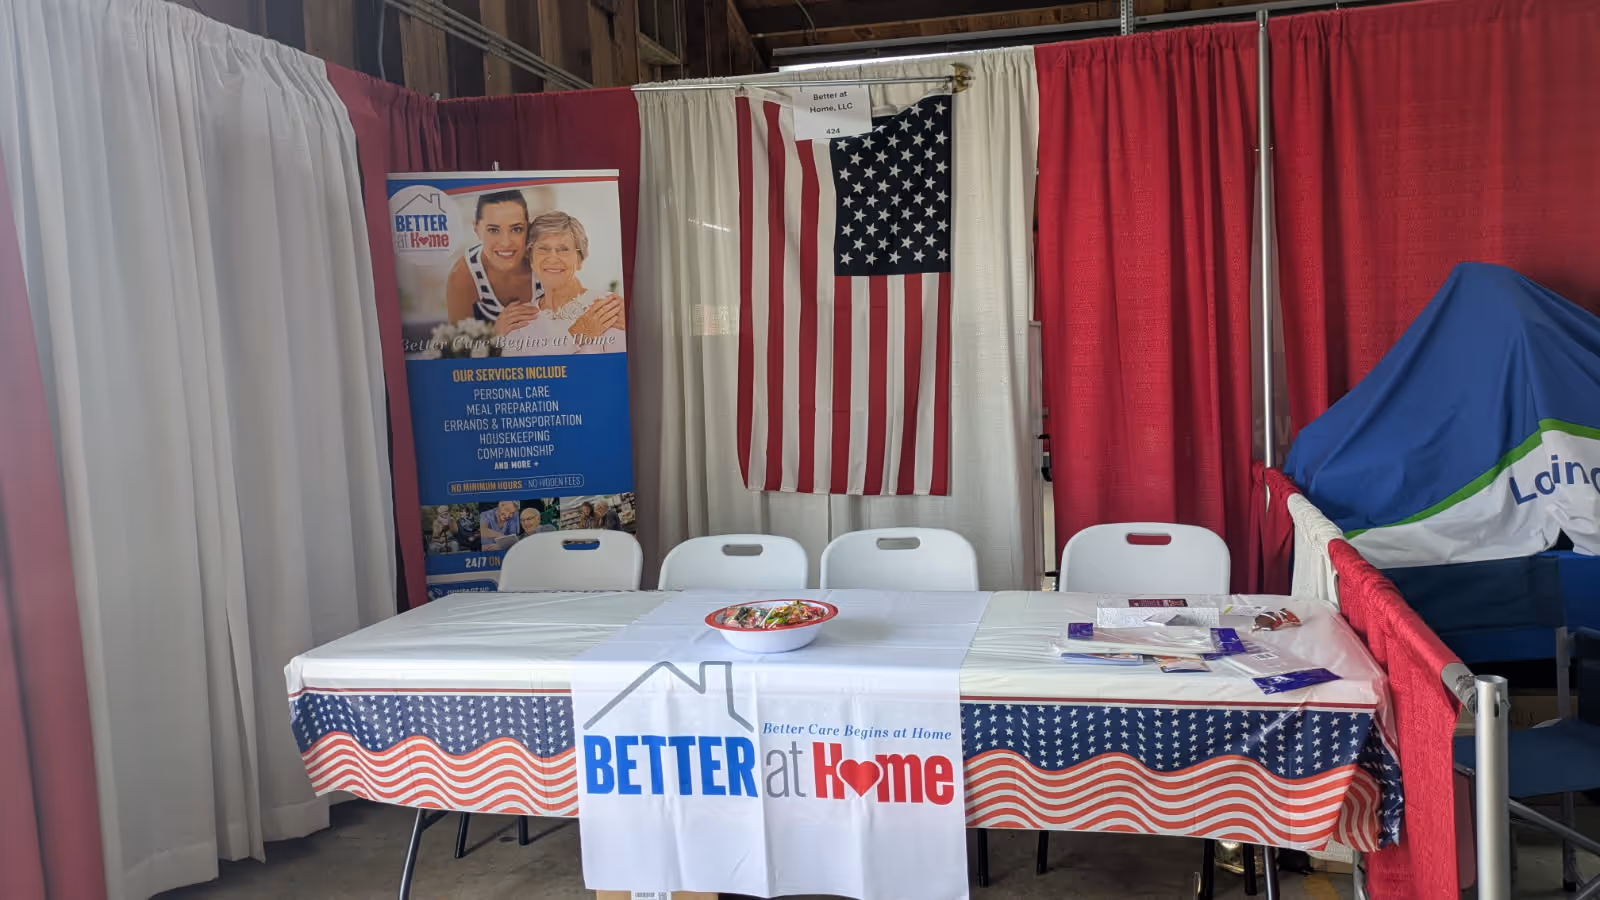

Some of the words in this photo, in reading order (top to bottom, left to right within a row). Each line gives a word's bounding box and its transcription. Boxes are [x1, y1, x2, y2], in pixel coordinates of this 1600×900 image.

[813, 93, 837, 101] Better
[809, 105, 837, 113] Home,
[838, 102, 853, 110] LLC
[395, 214, 448, 232] BETTER
[396, 232, 409, 248] at
[403, 338, 448, 351] Better
[452, 336, 490, 349] Care
[495, 335, 548, 350] Begins
[551, 333, 567, 345] at
[572, 332, 616, 345] Home
[452, 369, 474, 382] OUR
[475, 367, 524, 381] SERVICES
[525, 365, 568, 378] INCLUDE
[473, 387, 523, 400] PERSONAL
[525, 385, 550, 397] CARE
[466, 403, 492, 416] MEAL
[494, 400, 559, 414] PREPARATION
[444, 419, 489, 432] ERRANDS
[491, 418, 499, 429] &
[501, 414, 582, 429] TRANSPORTATION
[479, 430, 550, 444] HOUSEKEEPING
[477, 445, 555, 460] COMPANIONSHIP
[494, 461, 509, 470] AND
[511, 460, 531, 469] MORE
[451, 484, 461, 492] NO
[463, 481, 497, 492] MINIMUM
[498, 480, 522, 490] HOURS
[528, 479, 538, 488] NO
[564, 476, 581, 486] FEES
[465, 556, 487, 568] 24/7
[763, 722, 805, 735] Better
[808, 723, 840, 737] Care
[844, 725, 889, 740] Begins
[893, 727, 907, 738] at
[912, 728, 952, 741] Home
[583, 734, 759, 798] BETTER
[765, 741, 807, 798] at
